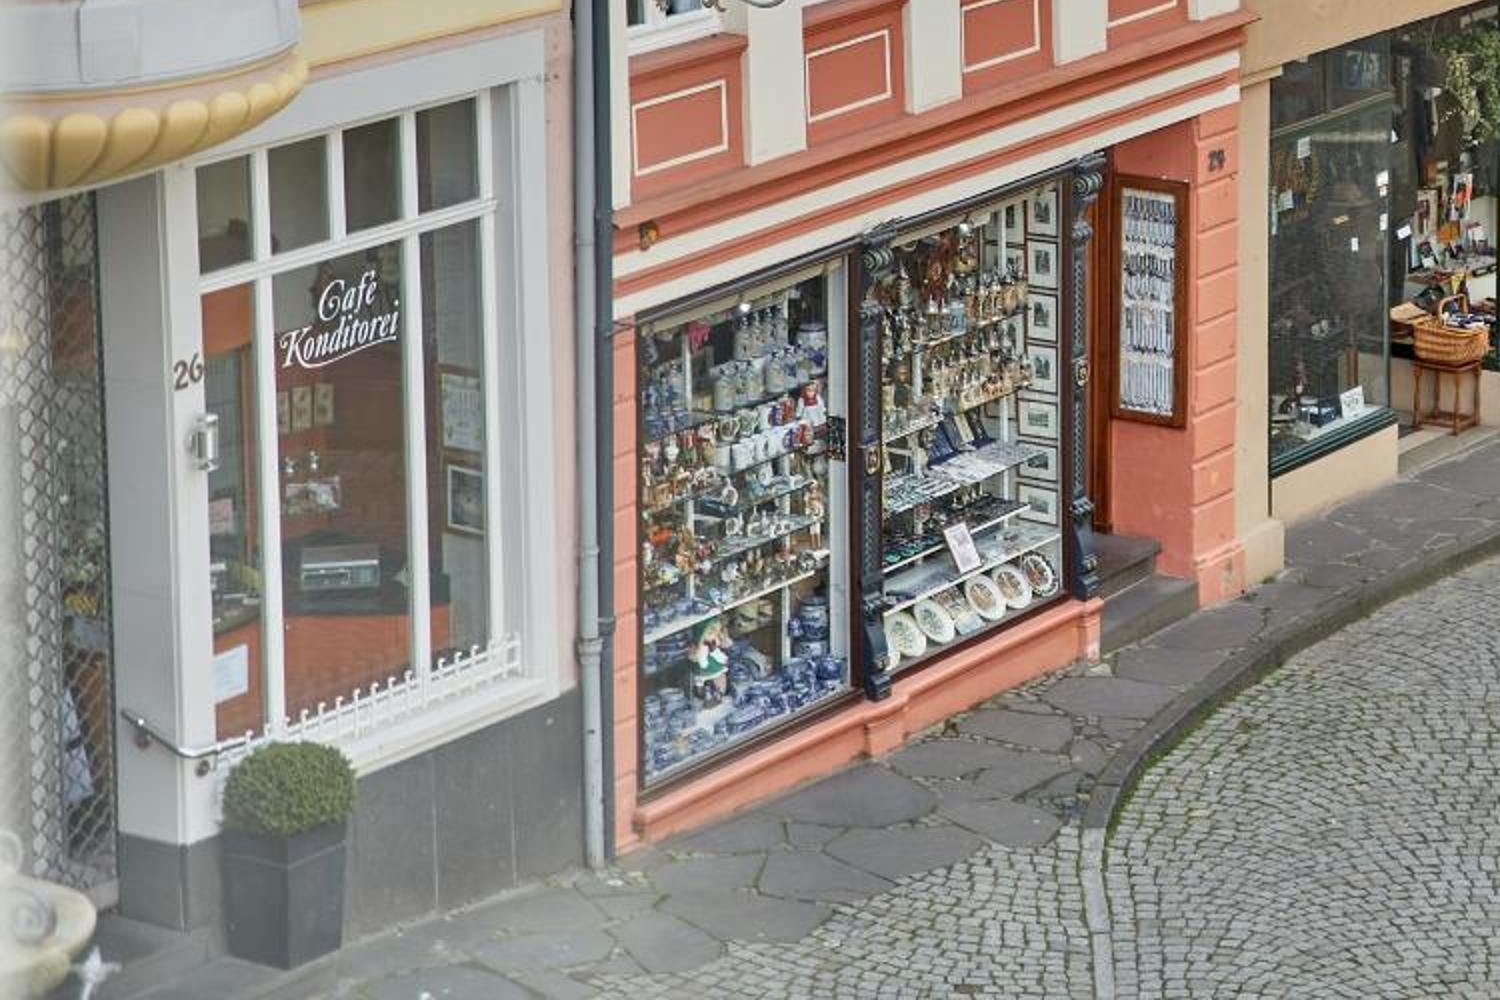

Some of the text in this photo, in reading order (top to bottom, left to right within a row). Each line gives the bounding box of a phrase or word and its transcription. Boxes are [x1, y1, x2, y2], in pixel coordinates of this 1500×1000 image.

[318, 269, 377, 321] Café
[279, 299, 399, 368] Konditorei
[173, 353, 205, 391] 26
